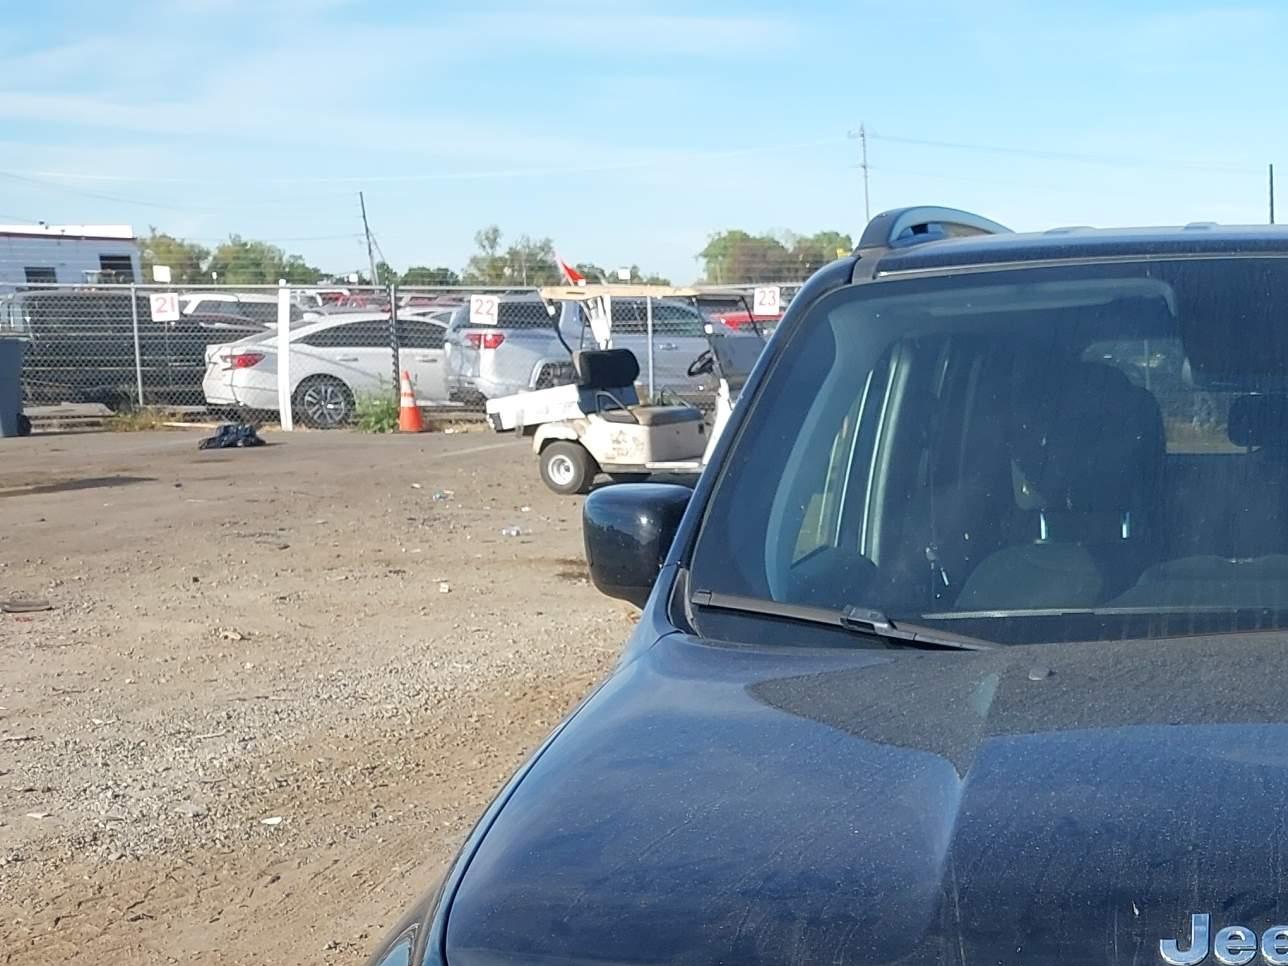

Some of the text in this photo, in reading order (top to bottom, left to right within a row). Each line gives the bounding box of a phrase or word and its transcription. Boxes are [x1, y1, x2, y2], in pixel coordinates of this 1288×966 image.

[155, 296, 176, 314] 21
[759, 289, 777, 306] 23
[474, 298, 495, 316] 22
